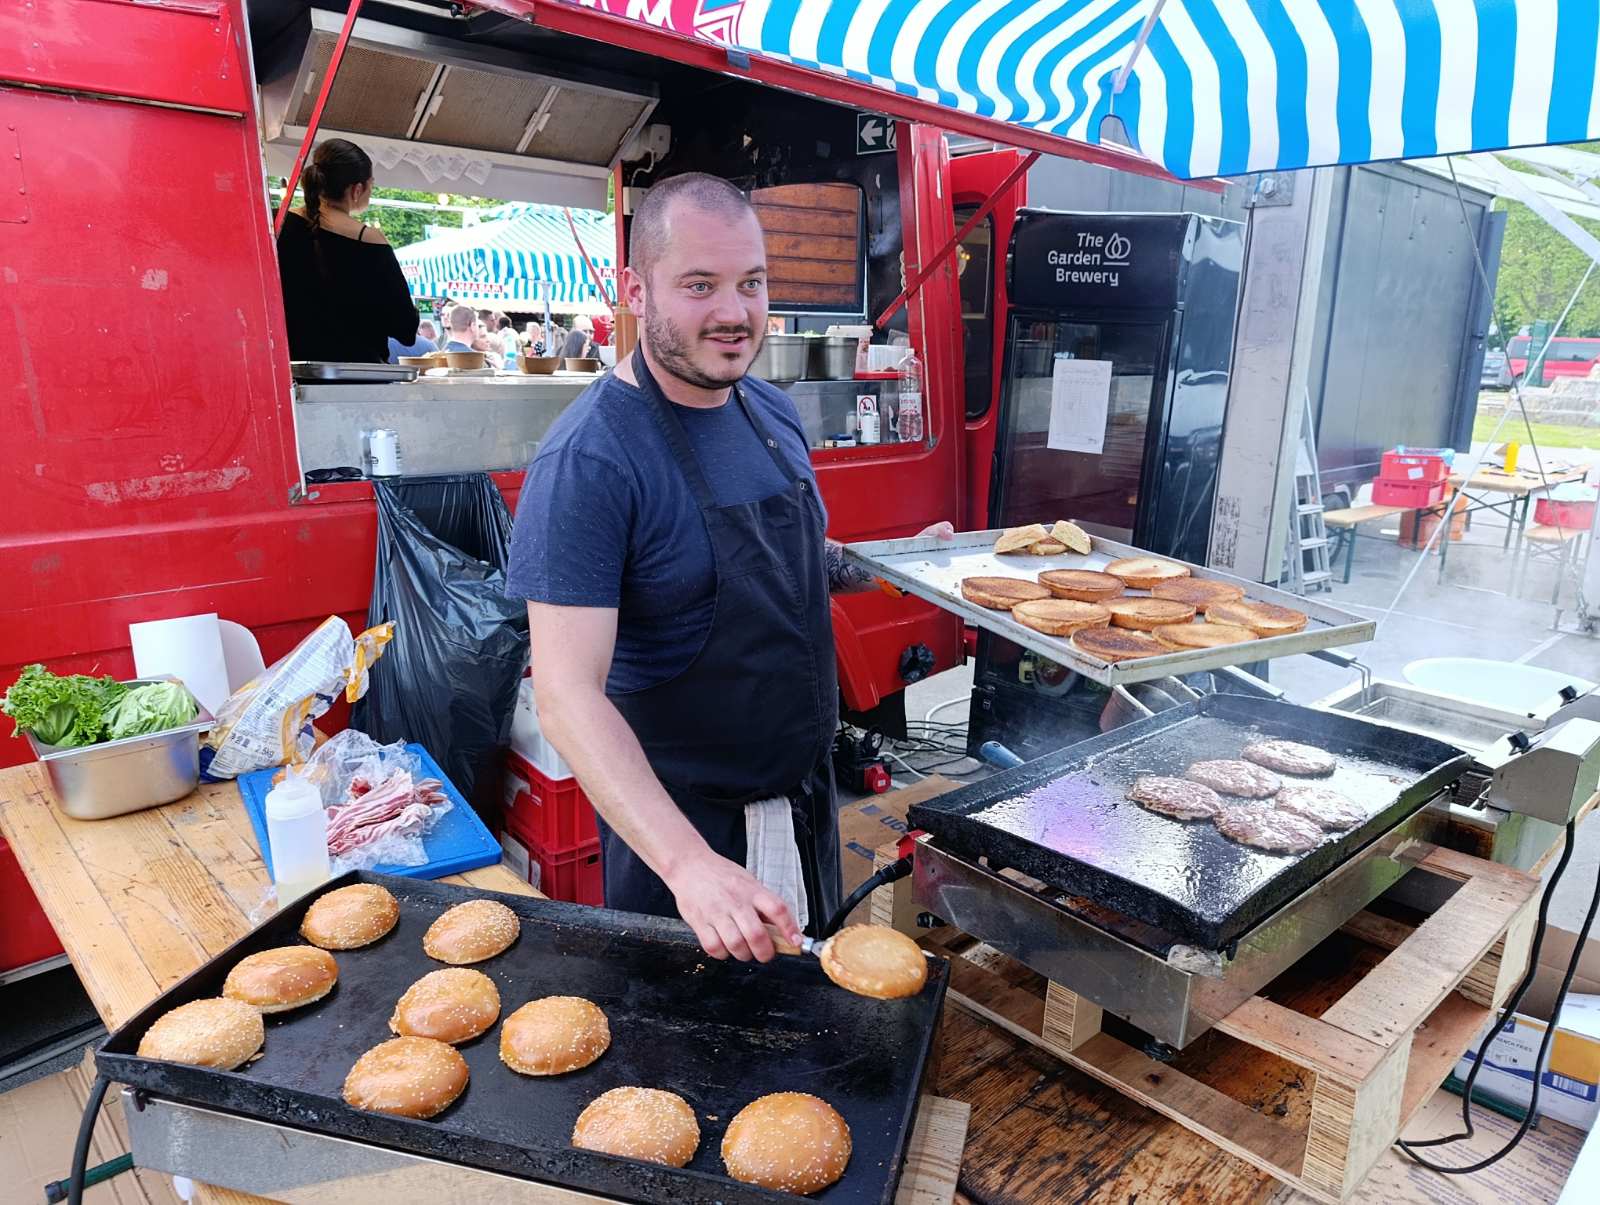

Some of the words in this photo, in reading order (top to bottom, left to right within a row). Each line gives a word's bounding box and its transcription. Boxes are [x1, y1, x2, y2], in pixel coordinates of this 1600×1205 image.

[1077, 232, 1104, 248] The
[1047, 250, 1101, 265] Garden
[1056, 268, 1119, 286] Brewery
